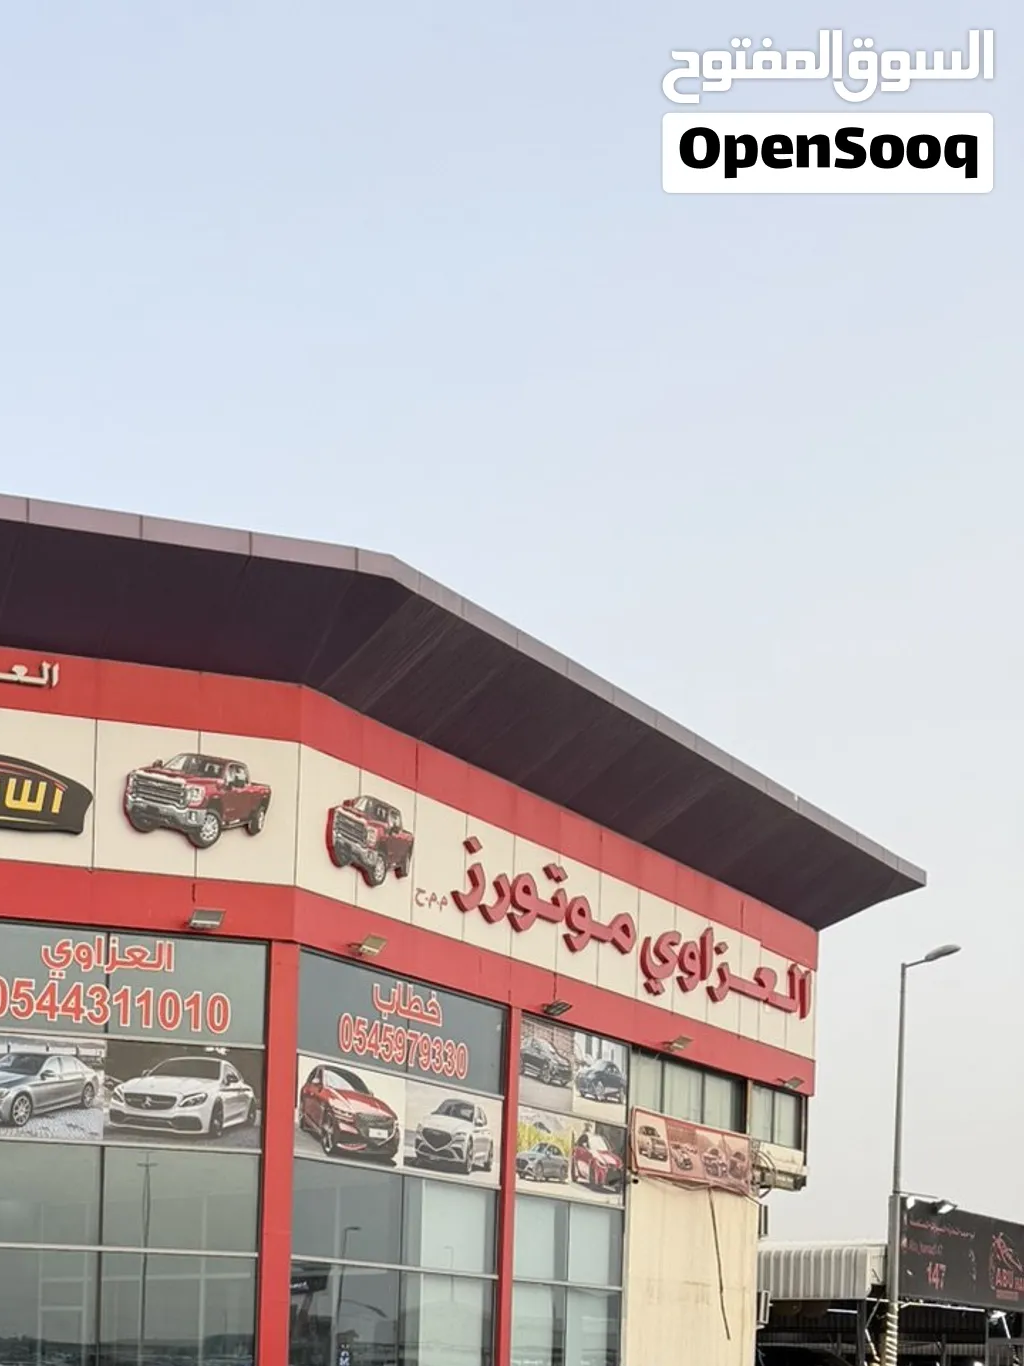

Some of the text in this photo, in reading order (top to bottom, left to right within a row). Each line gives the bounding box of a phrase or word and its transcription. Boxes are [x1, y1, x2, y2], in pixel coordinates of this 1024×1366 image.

[451, 835, 637, 954] موتورز
[41, 935, 176, 979] العزاوي
[640, 926, 812, 1020] العزاوي
[372, 981, 443, 1027] خطاب
[339, 1012, 469, 1080] 0545979330
